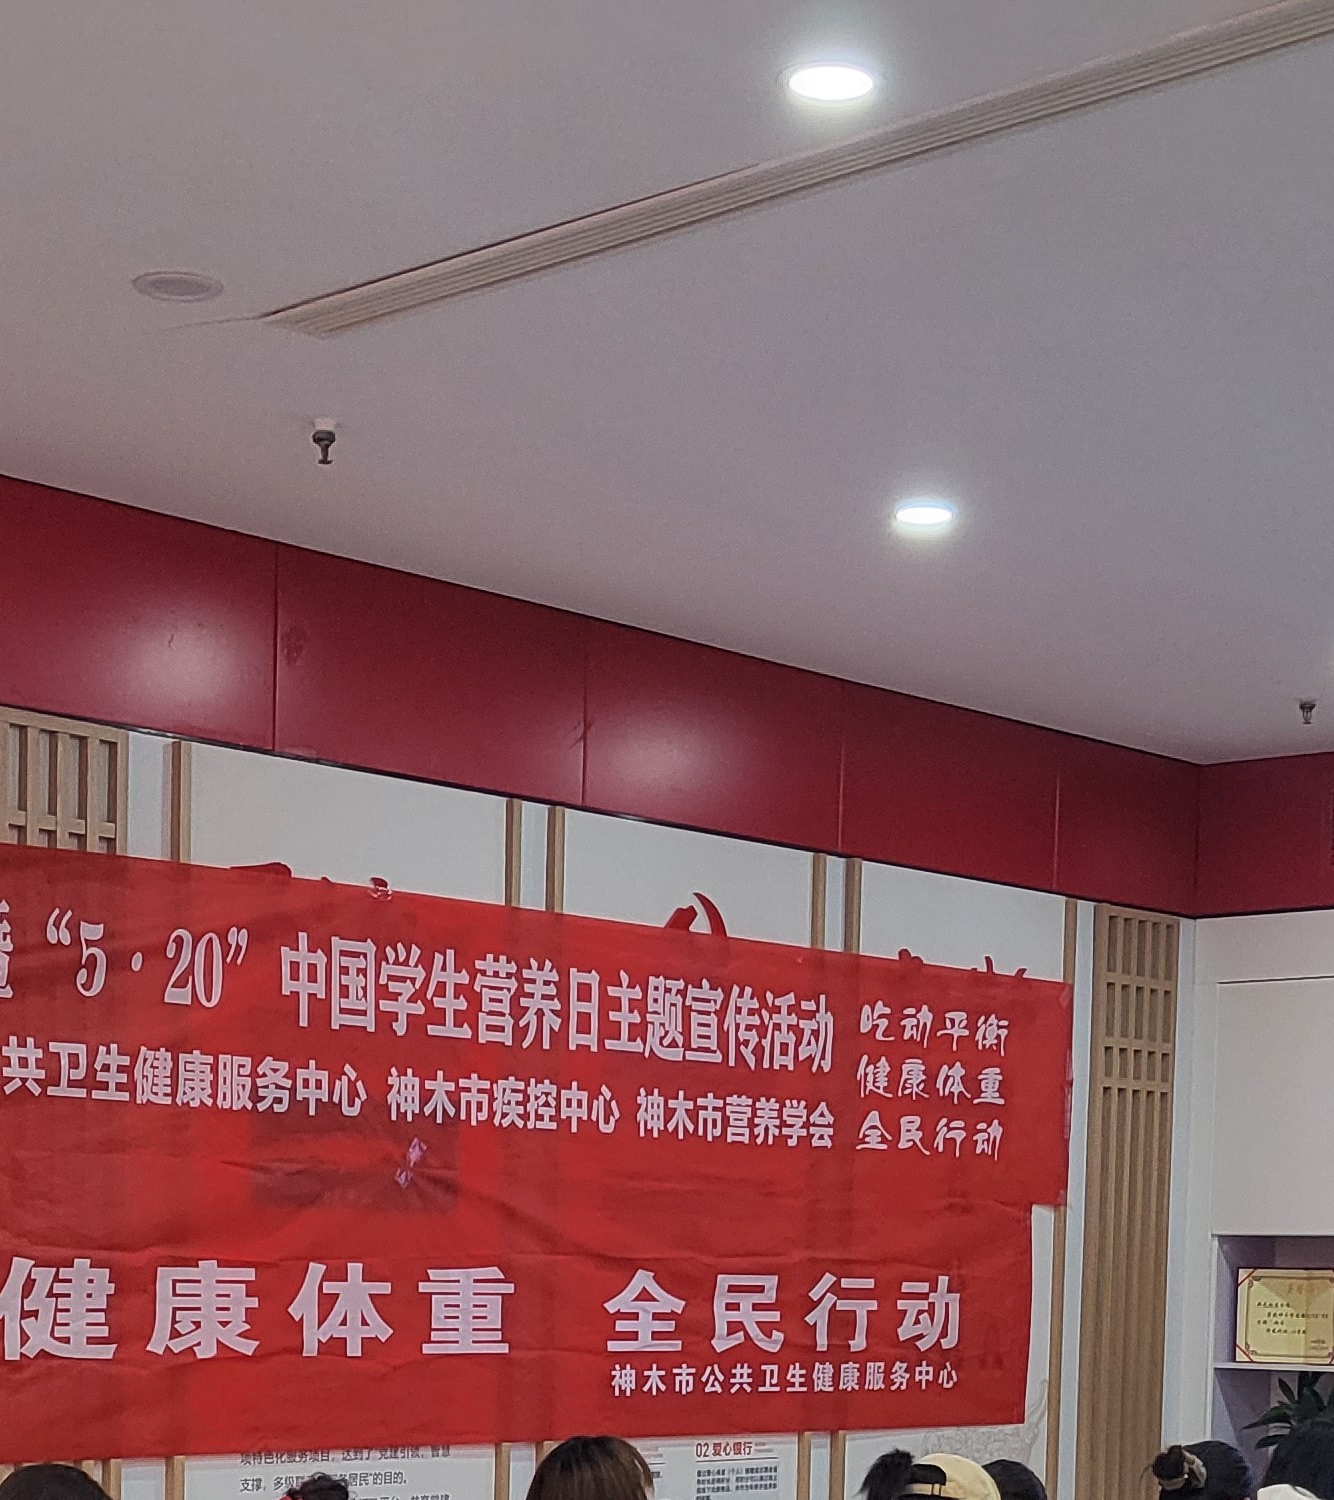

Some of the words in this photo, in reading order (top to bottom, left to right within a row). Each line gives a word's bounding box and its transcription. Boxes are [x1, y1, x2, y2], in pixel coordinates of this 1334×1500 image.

[281, 932, 833, 1073] 中国学生营养日主题宣传活动
[860, 1001, 1008, 1056] 吃动平衡
[857, 1055, 1004, 1104] 健康体重
[387, 1067, 619, 1133] 神木市疾控中心
[637, 1088, 834, 1148] 神木市营养学会
[856, 1111, 1002, 1160] 全民行动
[604, 1270, 960, 1352] 全民行动
[612, 1361, 957, 1396] 神木市公共卫生健康服务中心
